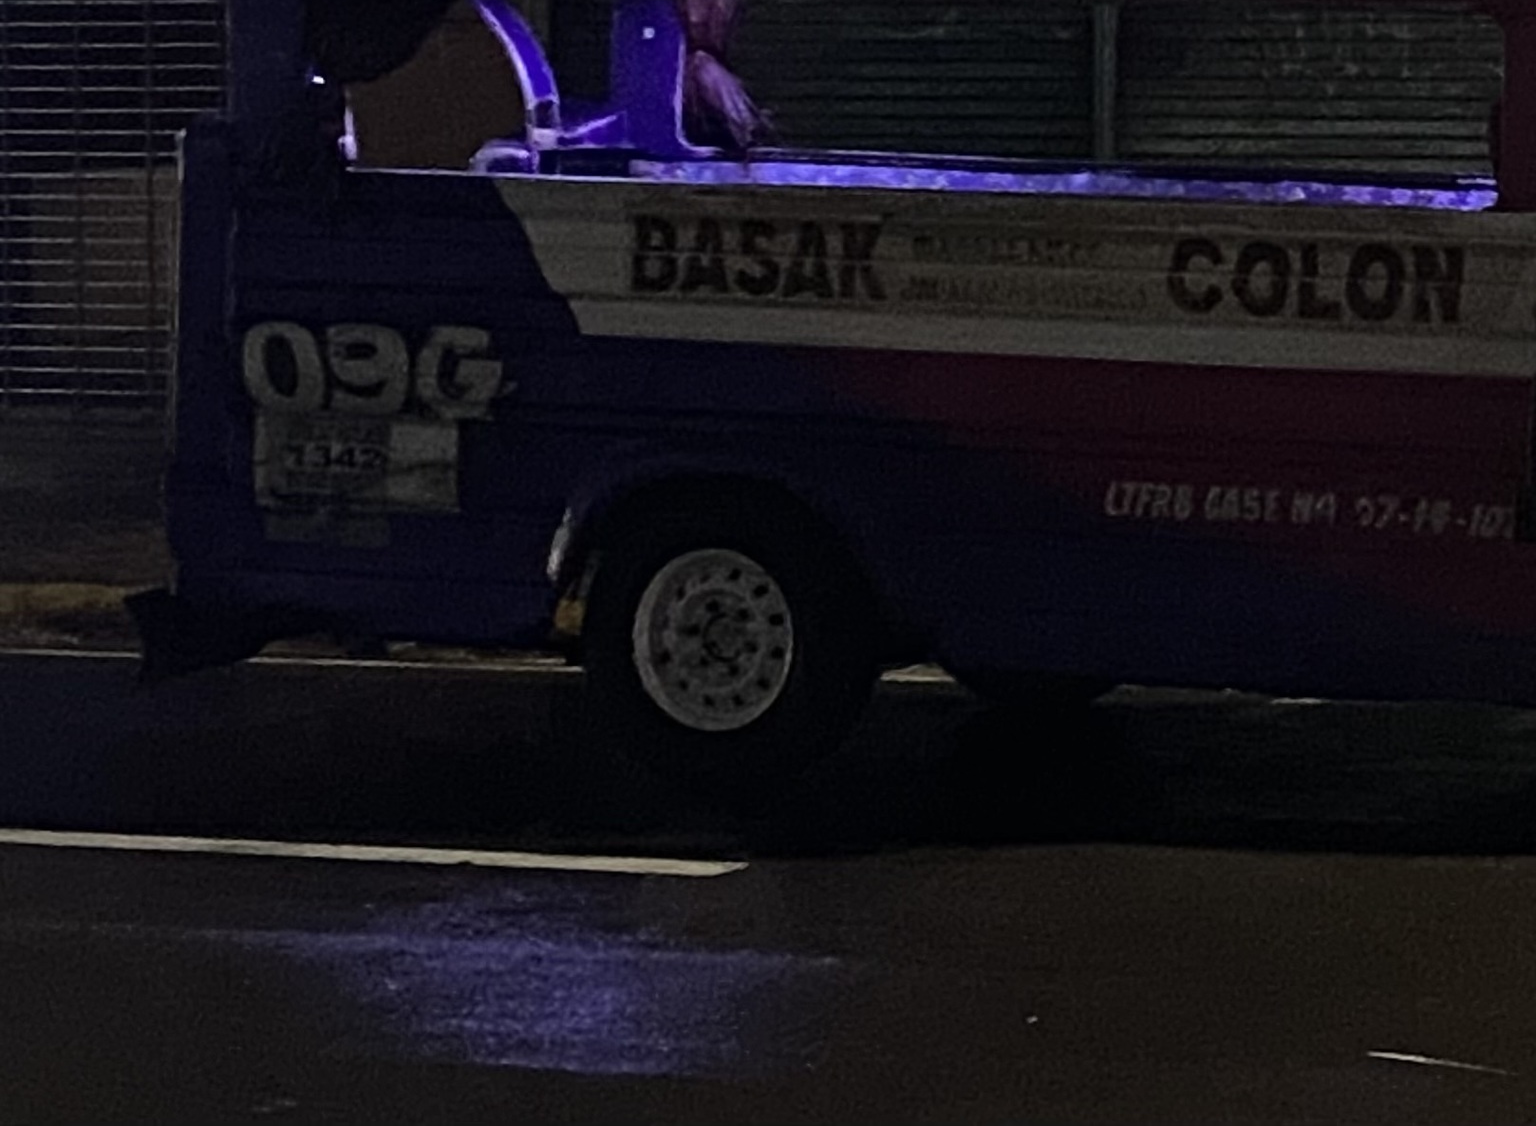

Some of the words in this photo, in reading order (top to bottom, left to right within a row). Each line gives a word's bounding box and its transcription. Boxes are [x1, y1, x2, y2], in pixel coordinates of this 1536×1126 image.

[631, 215, 884, 299] BASAK
[1169, 238, 1463, 322] COLON
[242, 321, 504, 420] 09G
[1204, 485, 1281, 522] CASE
